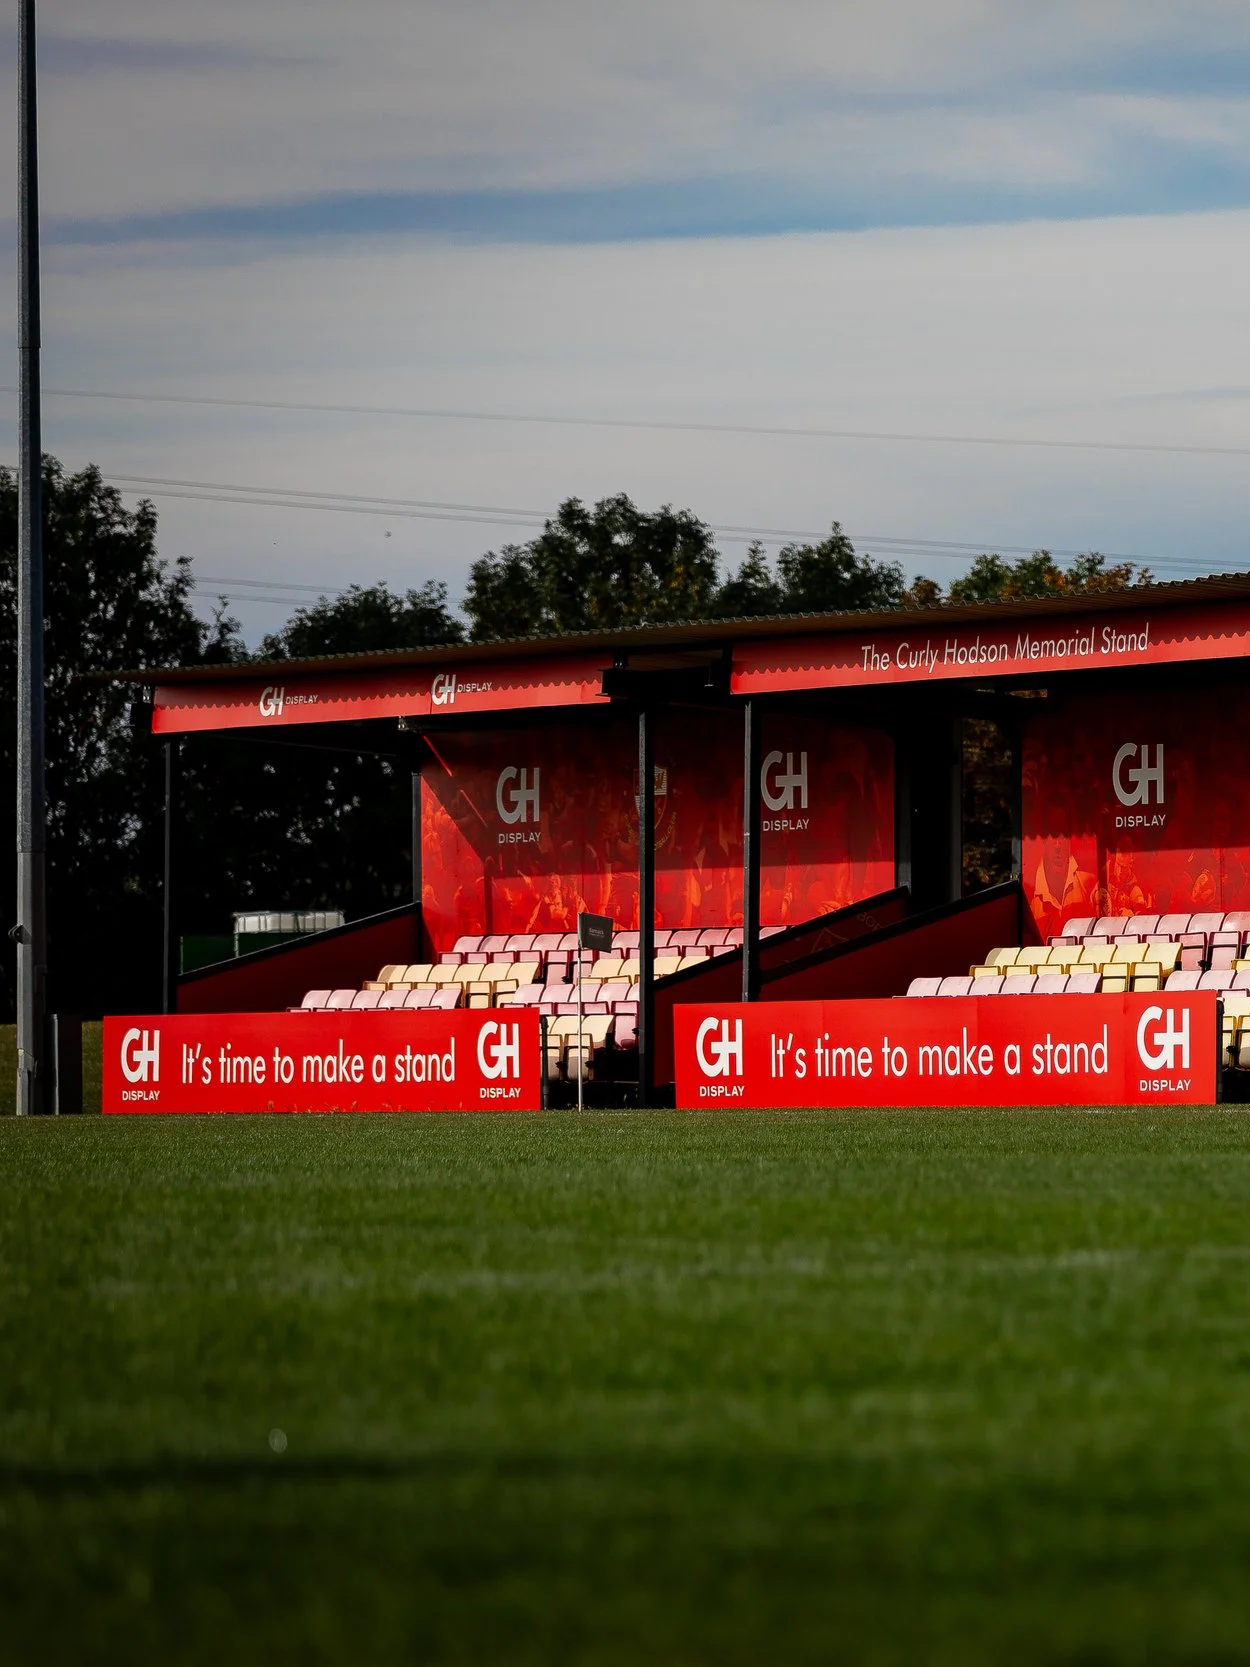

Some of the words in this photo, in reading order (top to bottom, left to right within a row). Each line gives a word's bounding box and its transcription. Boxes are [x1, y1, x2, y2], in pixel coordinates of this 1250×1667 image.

[861, 643, 890, 672] The
[896, 639, 939, 675] Curly
[944, 638, 1007, 665] Hodson
[1014, 628, 1095, 660] Memorial
[1101, 622, 1148, 654] Stand
[259, 686, 285, 717] GH
[285, 694, 318, 706] DISPLAY
[431, 674, 456, 705] GH
[457, 682, 492, 694] DISPLAY
[495, 766, 540, 825] GH
[760, 750, 808, 812] GH
[1112, 742, 1165, 808] GH
[498, 831, 541, 844] DISPLAY
[762, 818, 810, 832] DISPLAY
[1115, 814, 1166, 828] DISPLAY
[120, 1027, 161, 1083] GH
[182, 1042, 212, 1085] It's
[218, 1042, 266, 1084] time
[272, 1046, 295, 1084] to
[302, 1038, 365, 1084] make
[371, 1054, 386, 1083] a
[394, 1036, 455, 1083] stand
[476, 1020, 521, 1080] GH
[695, 1016, 744, 1078] GH
[771, 1032, 807, 1079] It's
[814, 1032, 873, 1078] time
[881, 1036, 908, 1077] to
[918, 1026, 994, 1076] make
[1003, 1043, 1021, 1076] a
[1031, 1023, 1108, 1075] stand
[1136, 1005, 1191, 1071] GH
[122, 1090, 160, 1101] DISPLAY
[480, 1087, 522, 1099] DISPLAY
[699, 1085, 745, 1097] DISPLAY
[1139, 1079, 1192, 1092] DISPLAY
